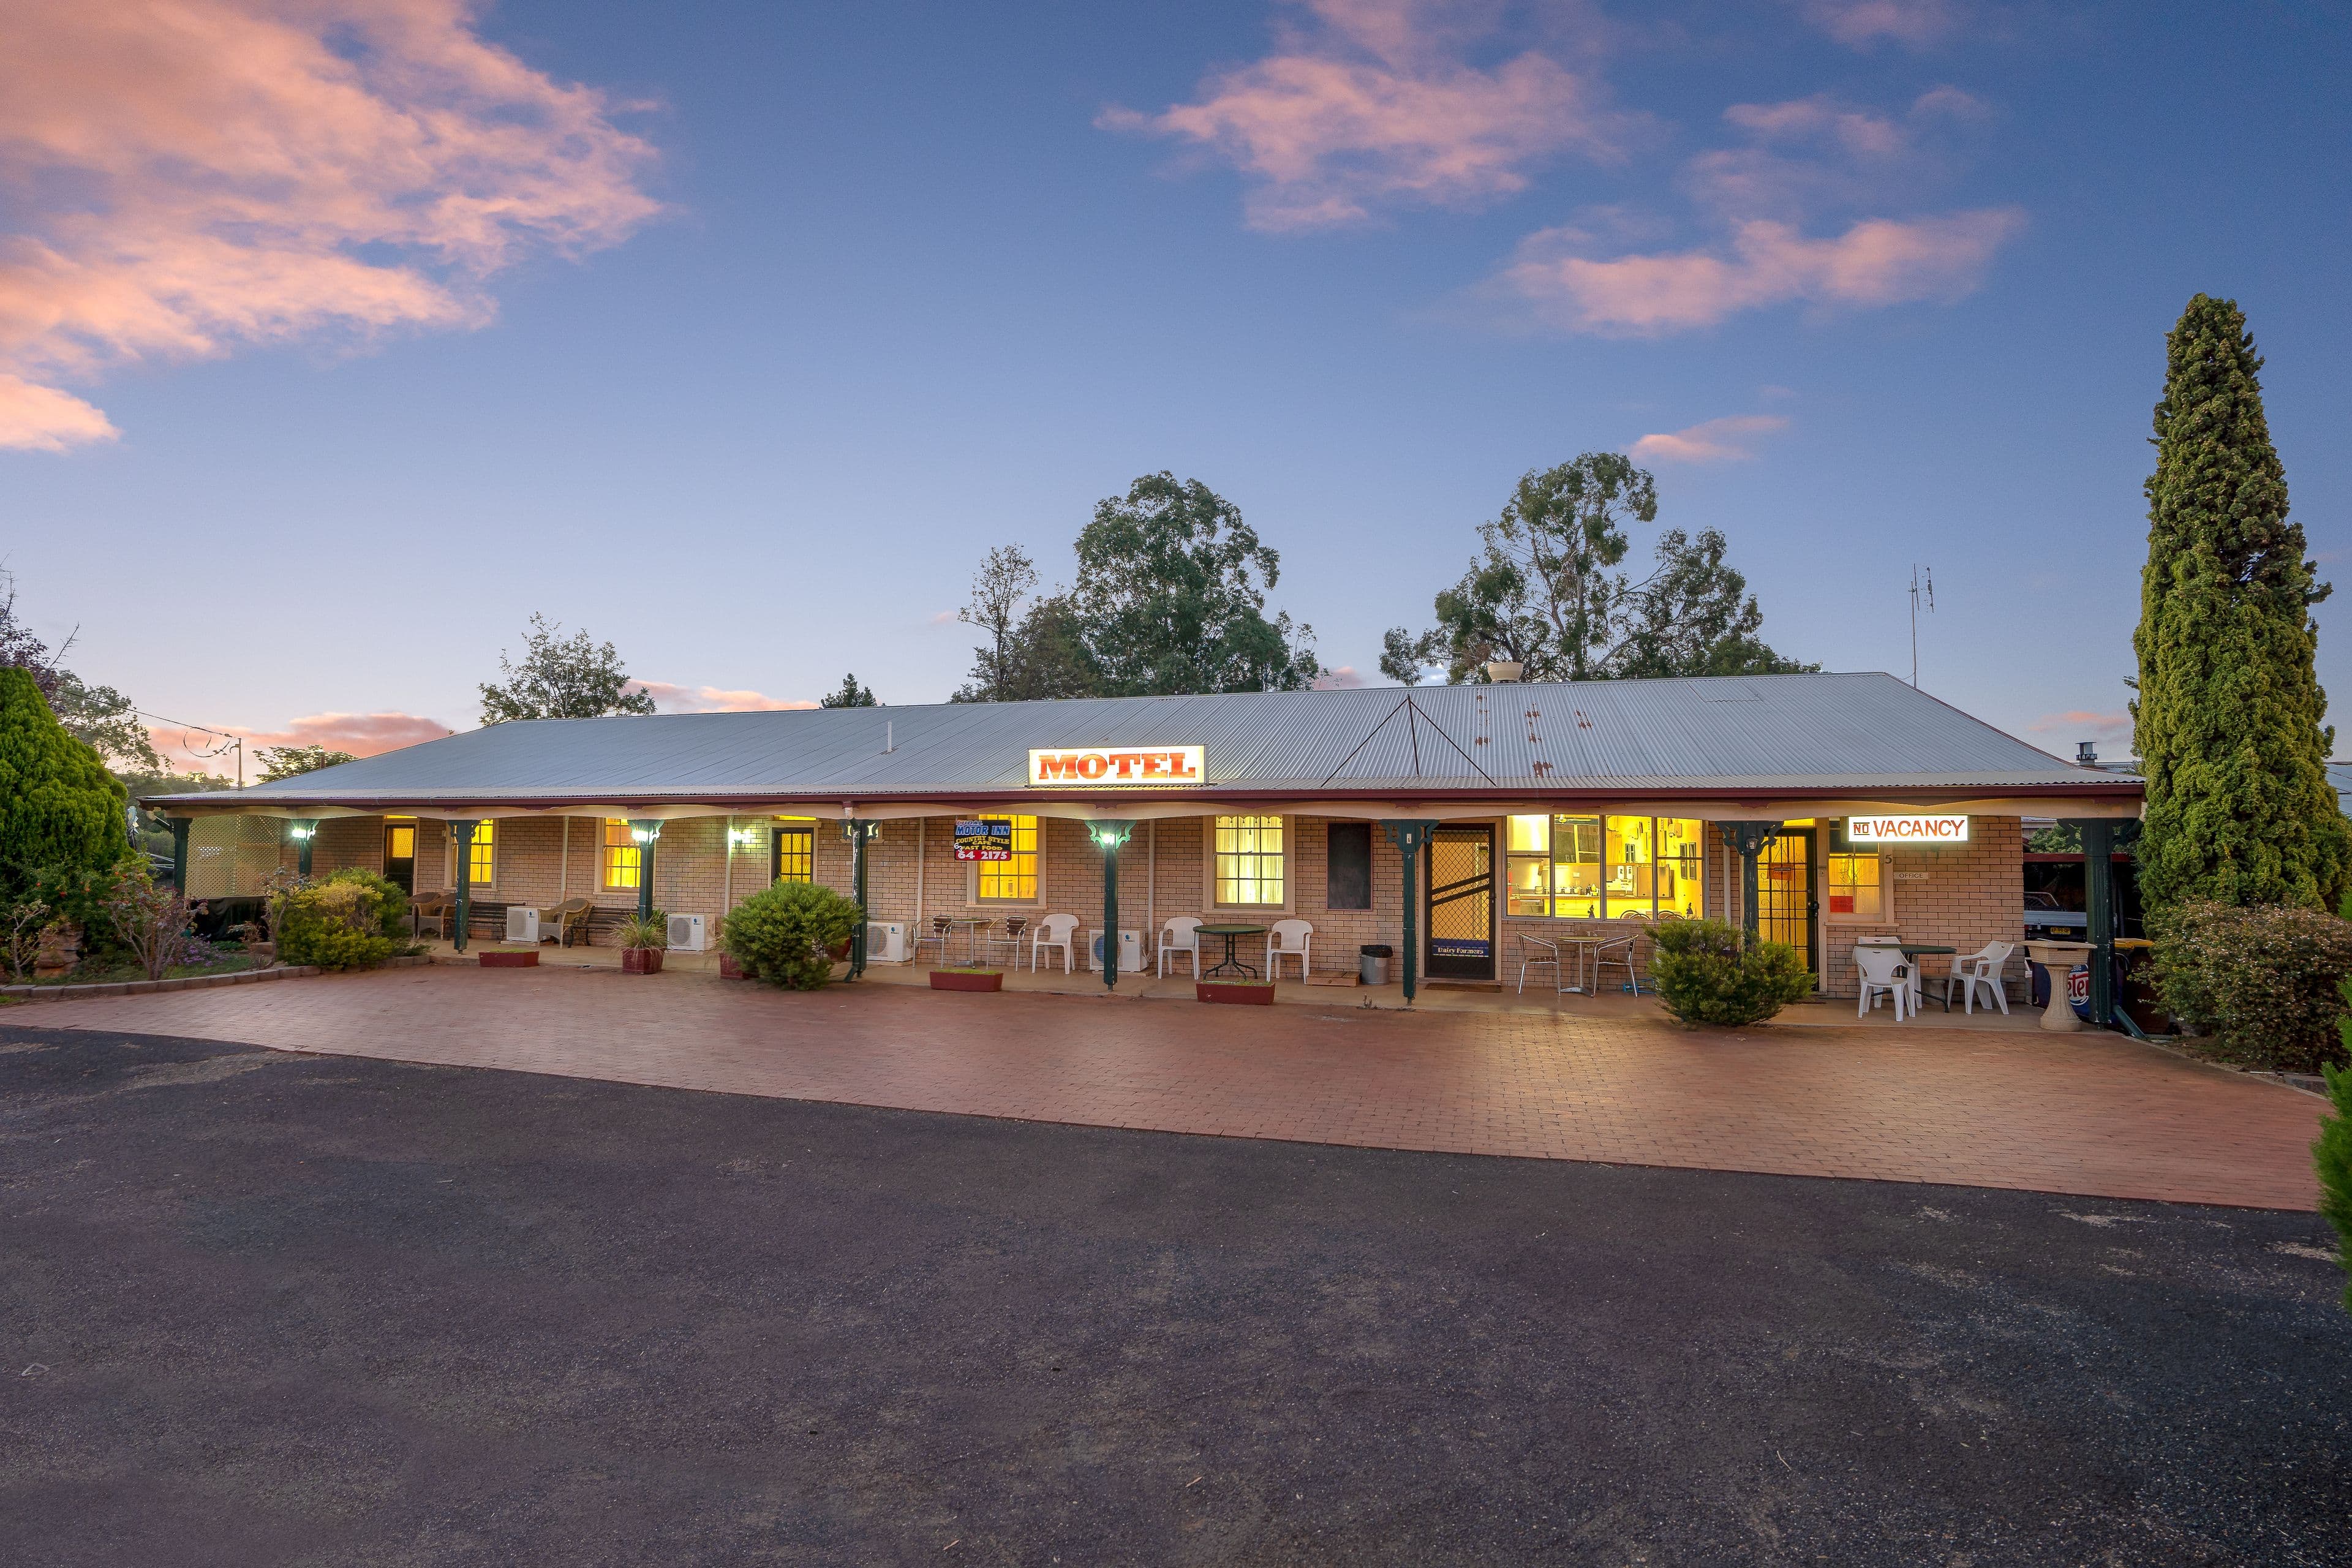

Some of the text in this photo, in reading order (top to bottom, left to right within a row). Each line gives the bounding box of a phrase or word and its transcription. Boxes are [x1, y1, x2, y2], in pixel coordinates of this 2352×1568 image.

[1039, 753, 1196, 779] MOTEL
[956, 826, 1010, 835] MOTOR INN
[1853, 820, 1965, 837] NO VACANCY
[981, 851, 1008, 859] 2175
[1885, 854, 1892, 864] 5
